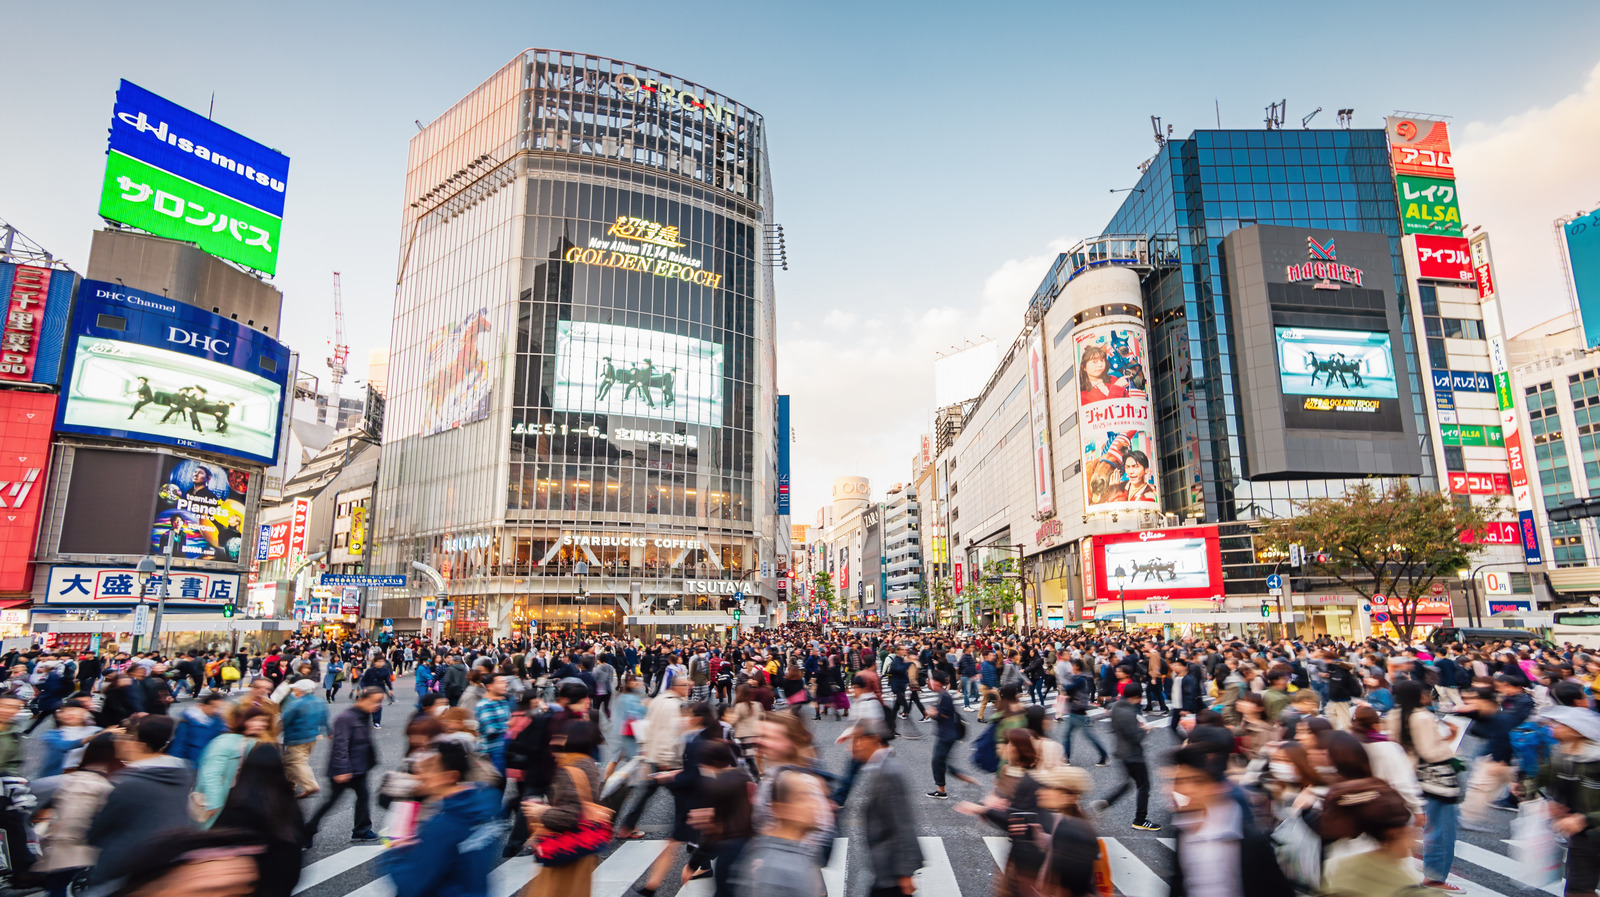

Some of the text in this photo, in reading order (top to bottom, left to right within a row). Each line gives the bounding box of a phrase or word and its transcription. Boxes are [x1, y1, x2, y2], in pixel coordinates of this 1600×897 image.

[118, 111, 285, 193] Hisamitsu
[1401, 148, 1454, 168] アコム
[1402, 182, 1454, 203] レイク
[117, 175, 272, 253] サロンパス
[1406, 203, 1460, 222] ALSA
[589, 237, 701, 268] New Album 11.14 Release
[1418, 248, 1470, 264] アイフル
[566, 246, 722, 289] GOLDEN EPOCH
[1287, 262, 1364, 287] MAGNET
[1460, 270, 1472, 280] 8F
[1480, 272, 1492, 297] アイフル
[96, 289, 176, 312] DHC Channel
[166, 326, 230, 356] DHC
[1434, 376, 1490, 389] レオパレス21
[177, 438, 196, 447] DHC
[1461, 430, 1480, 438] ALSA
[1454, 477, 1492, 490] アコム
[177, 498, 229, 517] Planets
[186, 494, 218, 505] teamLab
[188, 523, 216, 532] TOYOSU
[270, 524, 287, 538] オケ
[293, 504, 306, 543] カラオケ
[563, 535, 701, 549] STARBUCKS COFFEE
[1522, 518, 1536, 550] PROMISE
[59, 574, 232, 600] 大盛堂書店
[687, 580, 752, 594] TSUTAYA
[1492, 604, 1517, 612] PROMISE
